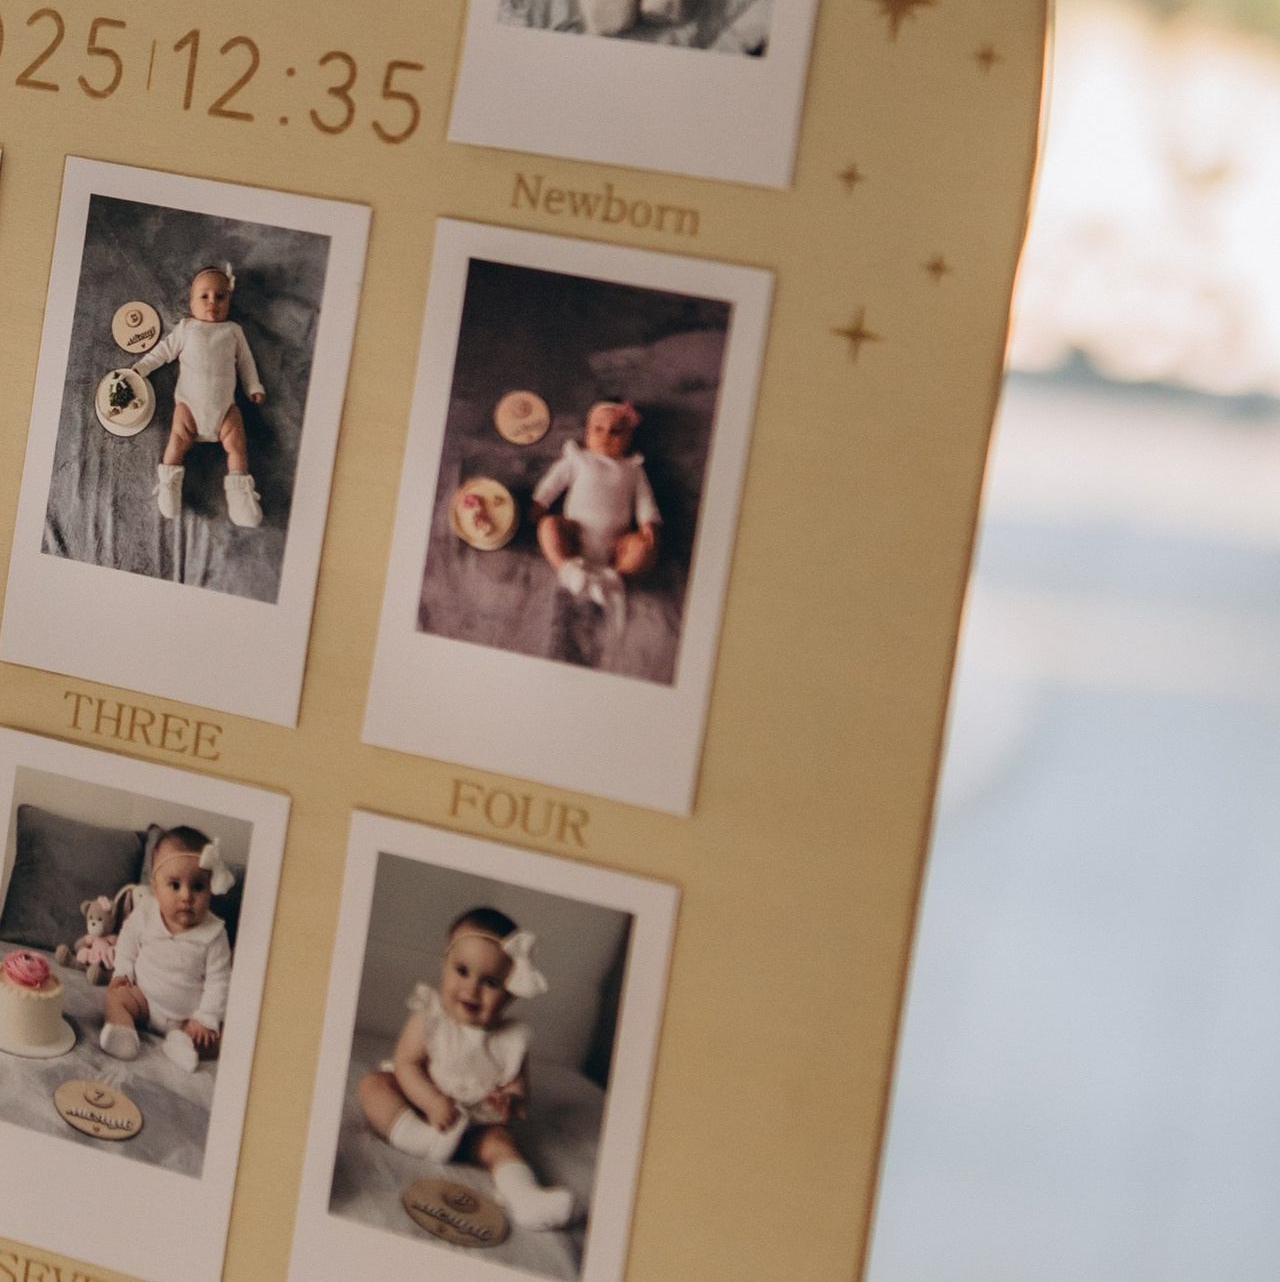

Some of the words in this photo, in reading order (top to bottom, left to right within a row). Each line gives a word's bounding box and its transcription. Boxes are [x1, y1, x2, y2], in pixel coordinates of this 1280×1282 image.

[510, 172, 701, 237] Newborn
[63, 690, 223, 761] THREE
[448, 778, 590, 849] FOUR
